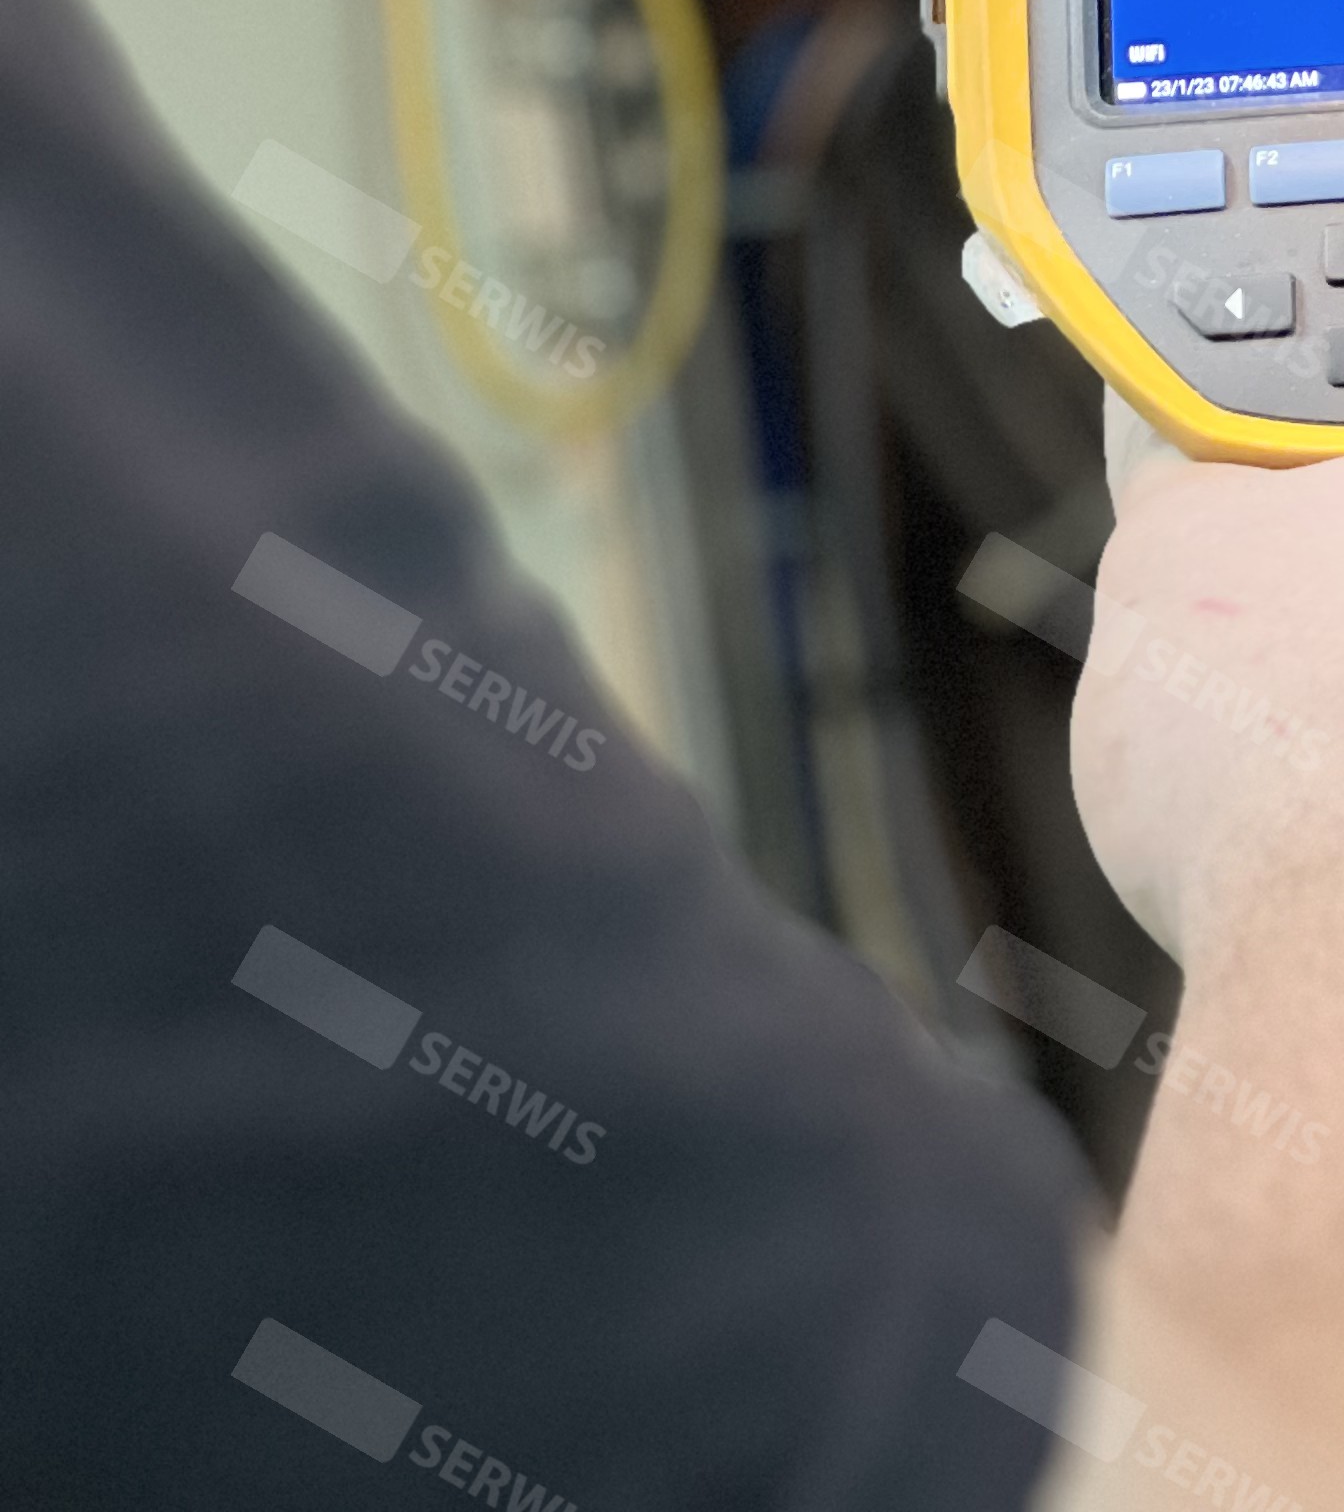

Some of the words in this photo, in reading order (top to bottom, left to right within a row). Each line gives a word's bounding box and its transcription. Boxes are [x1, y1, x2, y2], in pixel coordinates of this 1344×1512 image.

[1151, 76, 1214, 98] 23/1/23
[1218, 71, 1287, 93] 07:46:43
[1289, 69, 1319, 88] AM
[1256, 150, 1279, 166] F2
[1112, 162, 1132, 178] F1
